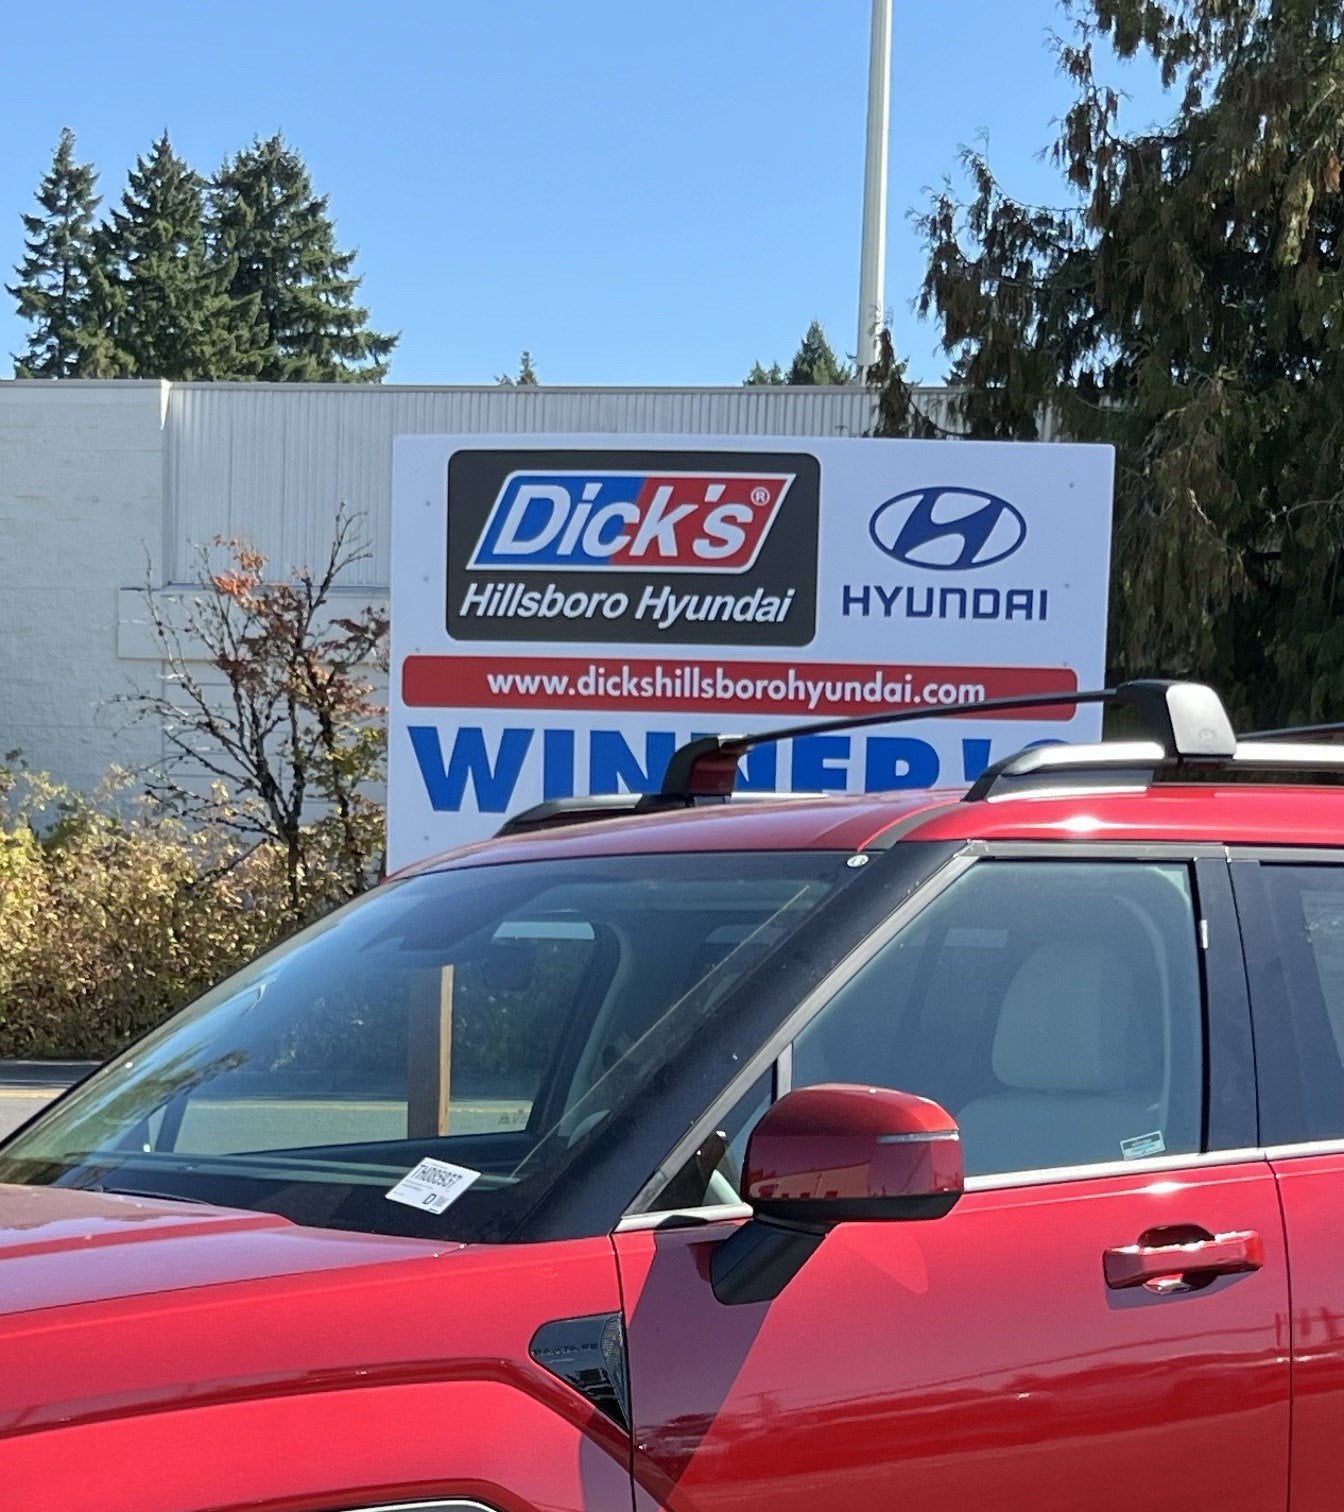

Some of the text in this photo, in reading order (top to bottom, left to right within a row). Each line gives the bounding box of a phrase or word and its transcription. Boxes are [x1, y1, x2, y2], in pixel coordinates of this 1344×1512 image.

[459, 583, 796, 630] Hillsboro Hyundai
[843, 585, 1049, 621] HYUNDAI
[487, 667, 987, 710] www.dickshillsborohyundai.com
